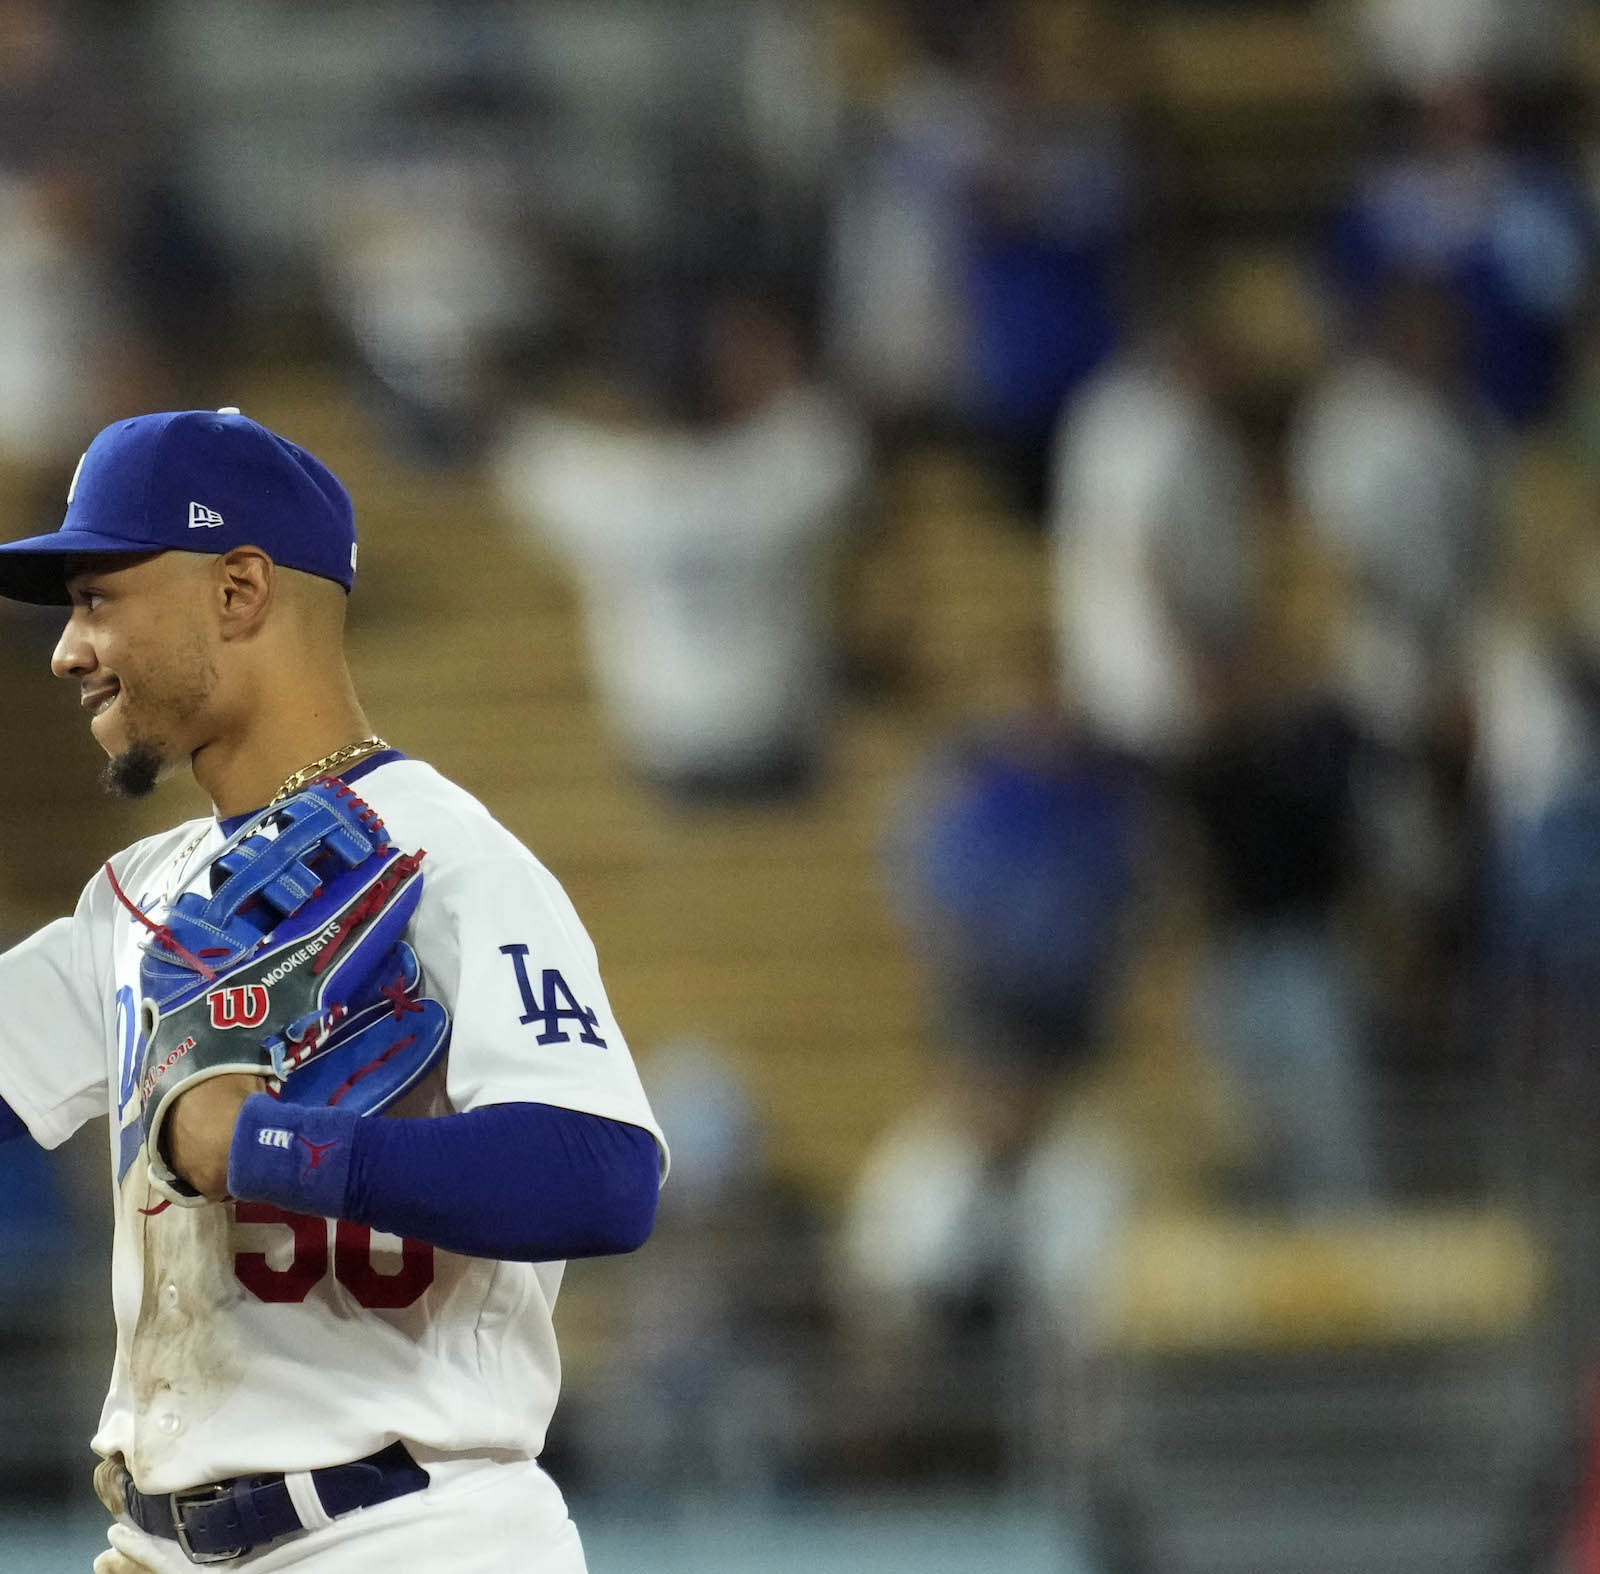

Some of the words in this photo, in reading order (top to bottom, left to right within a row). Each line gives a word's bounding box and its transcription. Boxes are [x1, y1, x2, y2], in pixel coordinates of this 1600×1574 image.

[261, 948, 311, 988] MOOKIE
[305, 921, 341, 956] BETTS
[499, 943, 608, 1050] LA
[142, 1036, 197, 1112] ilson
[258, 1129, 295, 1150] MB
